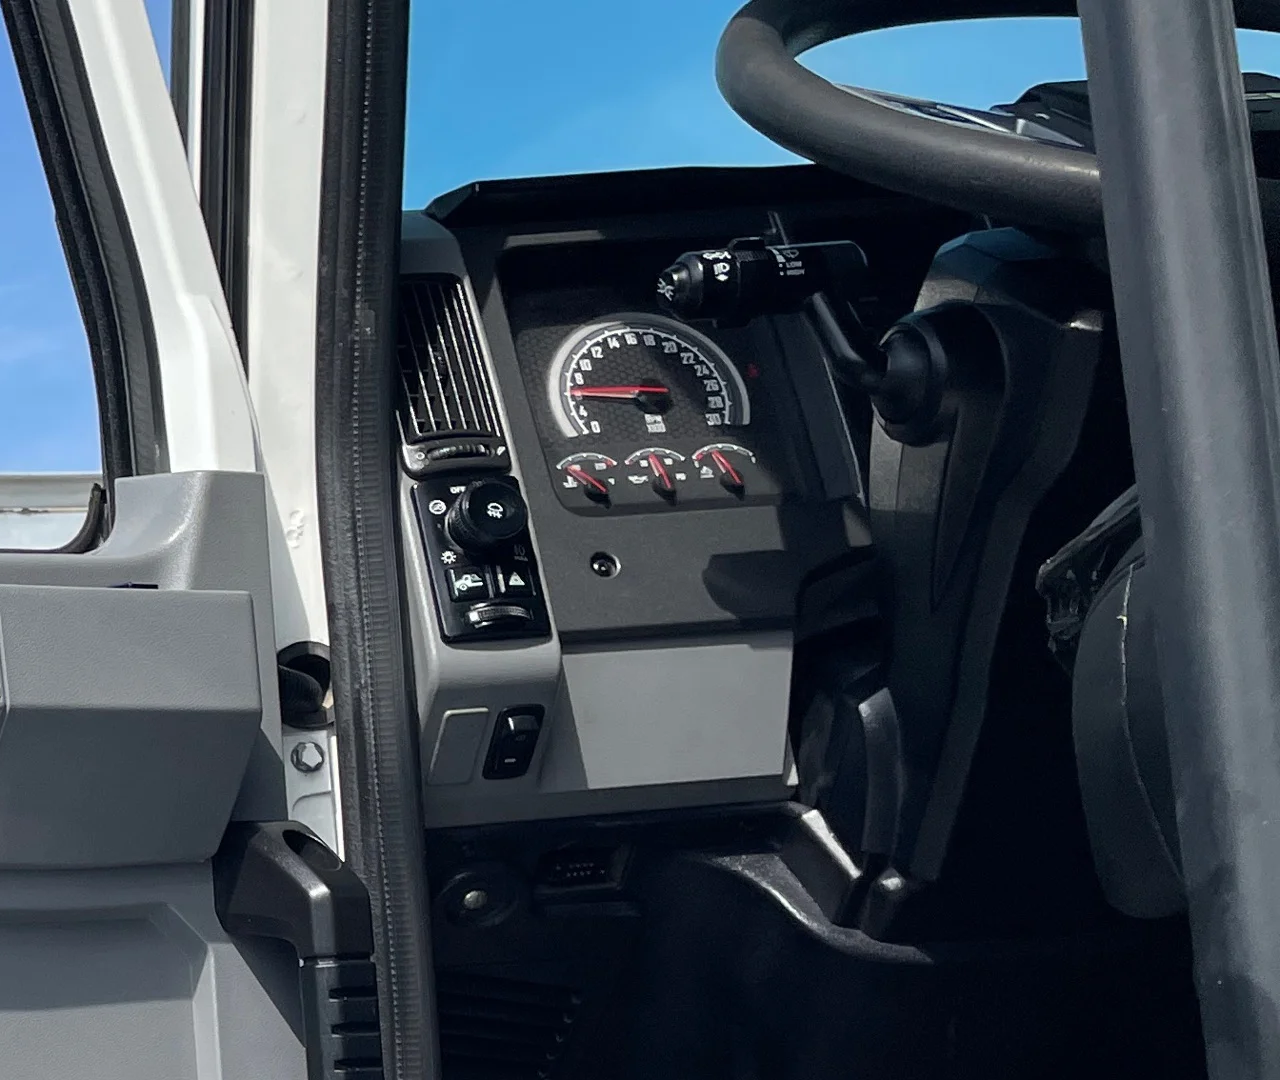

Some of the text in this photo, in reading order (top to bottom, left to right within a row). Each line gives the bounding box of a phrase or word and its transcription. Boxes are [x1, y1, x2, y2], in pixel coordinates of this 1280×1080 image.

[607, 337, 620, 349] 14
[624, 333, 637, 345] 16
[643, 334, 656, 346] 18
[591, 346, 603, 359] 12
[662, 341, 678, 354] 20
[680, 352, 696, 365] 22
[579, 359, 592, 371] 10
[694, 364, 710, 377] 24
[574, 372, 584, 385] 8
[704, 380, 719, 392] 26
[708, 396, 723, 408] 28
[579, 405, 588, 417] 4
[705, 413, 722, 426] 30
[590, 421, 600, 433] 0
